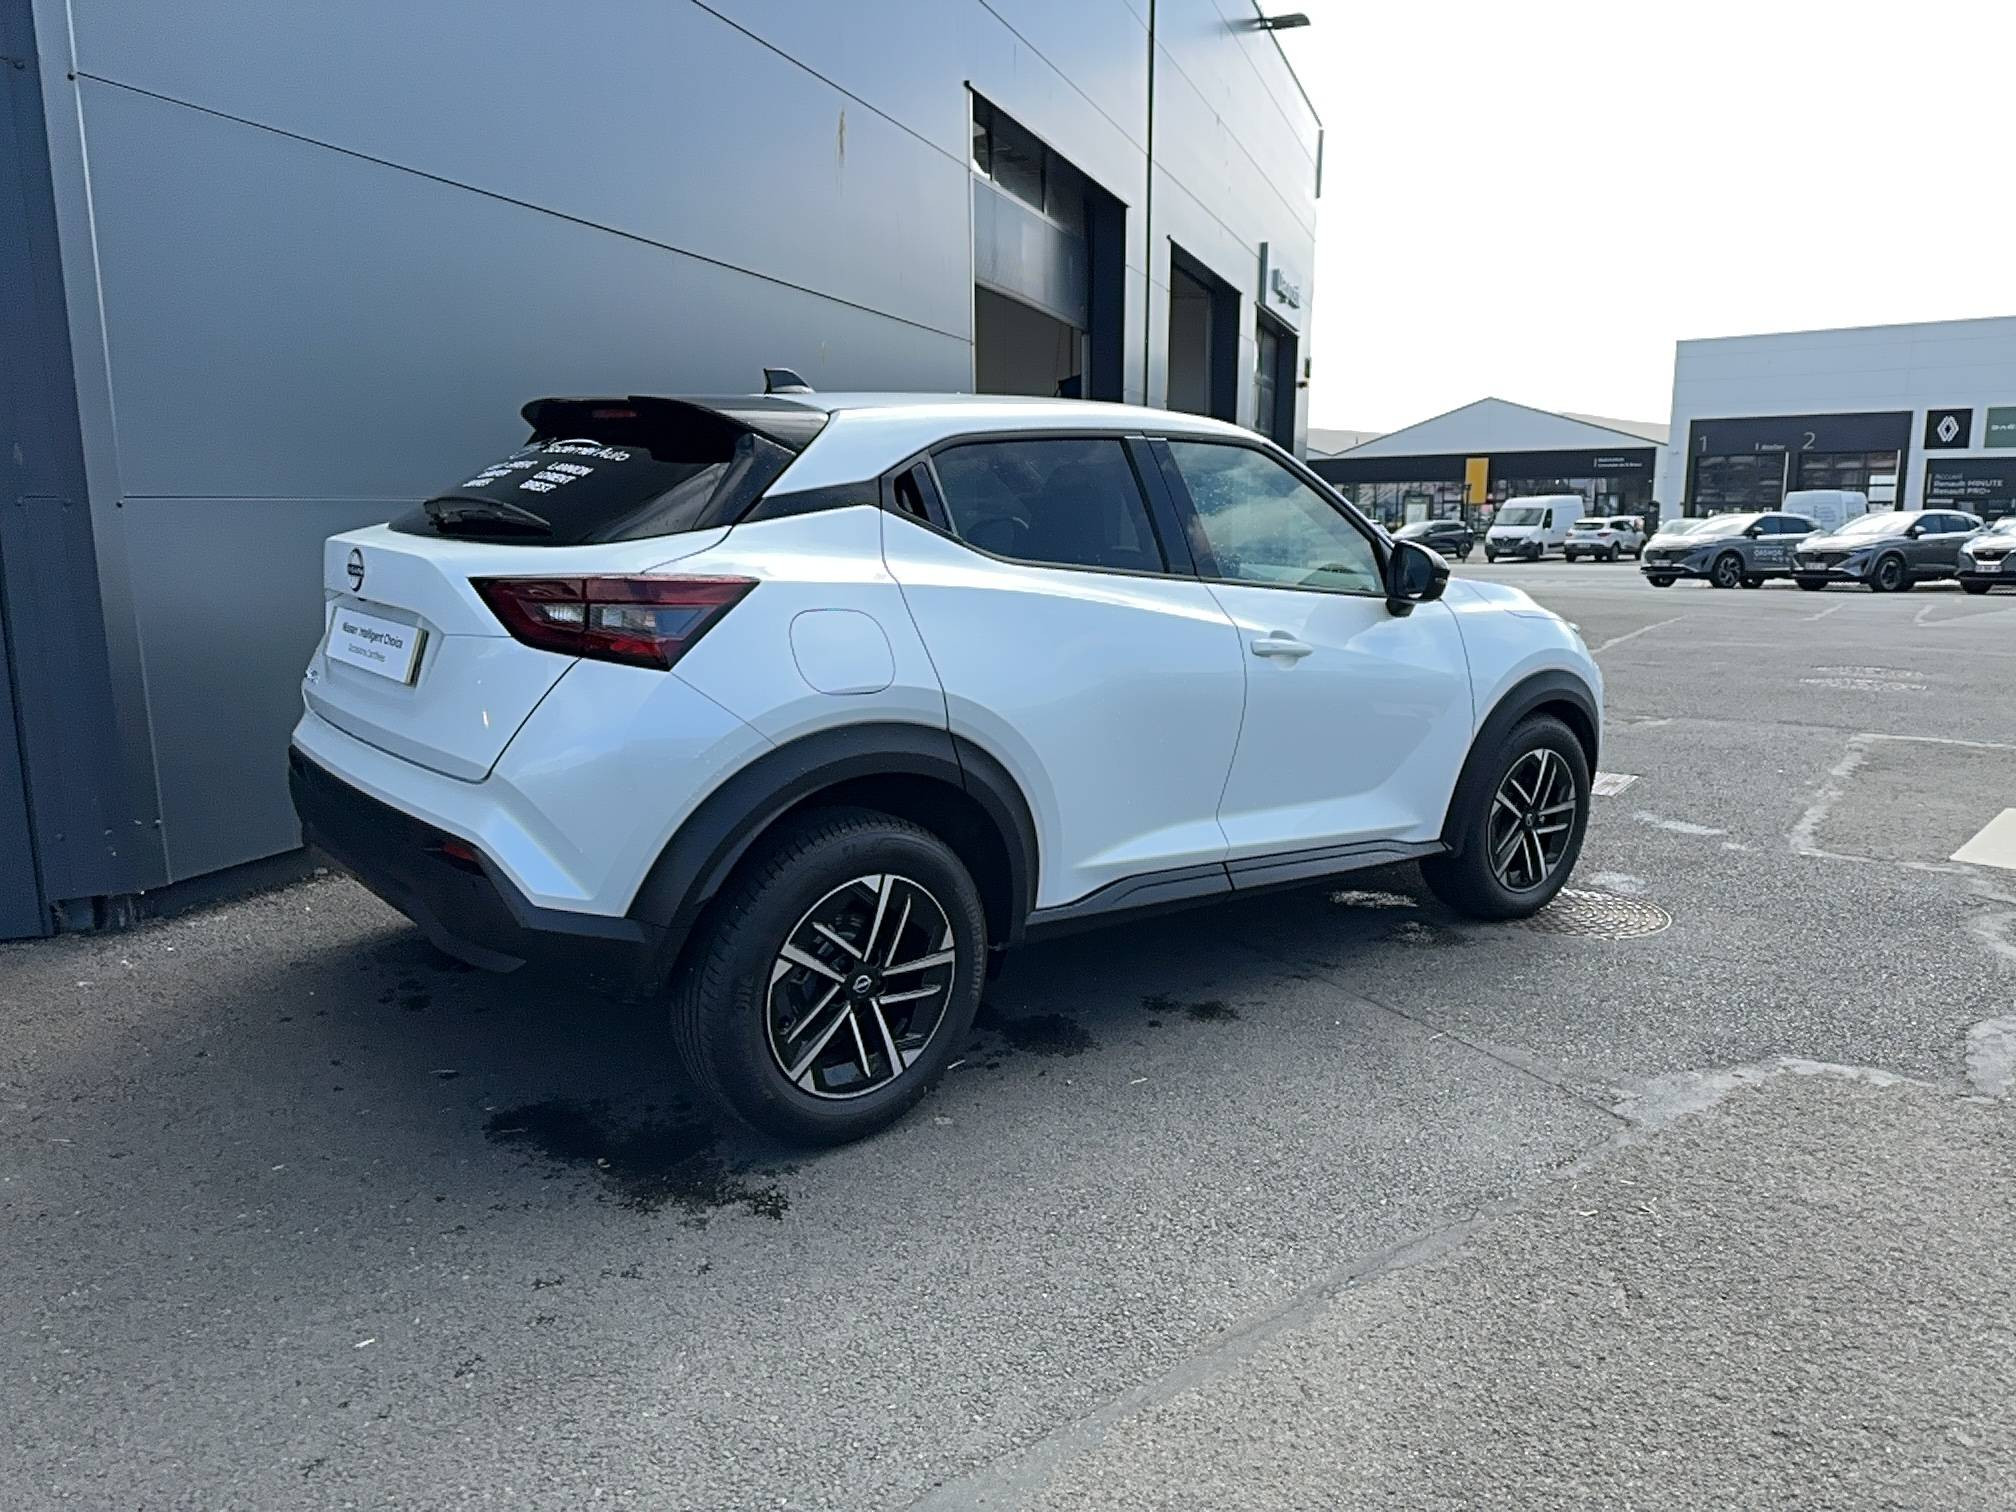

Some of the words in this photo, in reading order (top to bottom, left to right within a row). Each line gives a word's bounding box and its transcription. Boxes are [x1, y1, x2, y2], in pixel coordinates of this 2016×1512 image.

[1699, 435, 1707, 452] 1
[1802, 431, 1816, 450] 2
[384, 633, 404, 648] Choice
